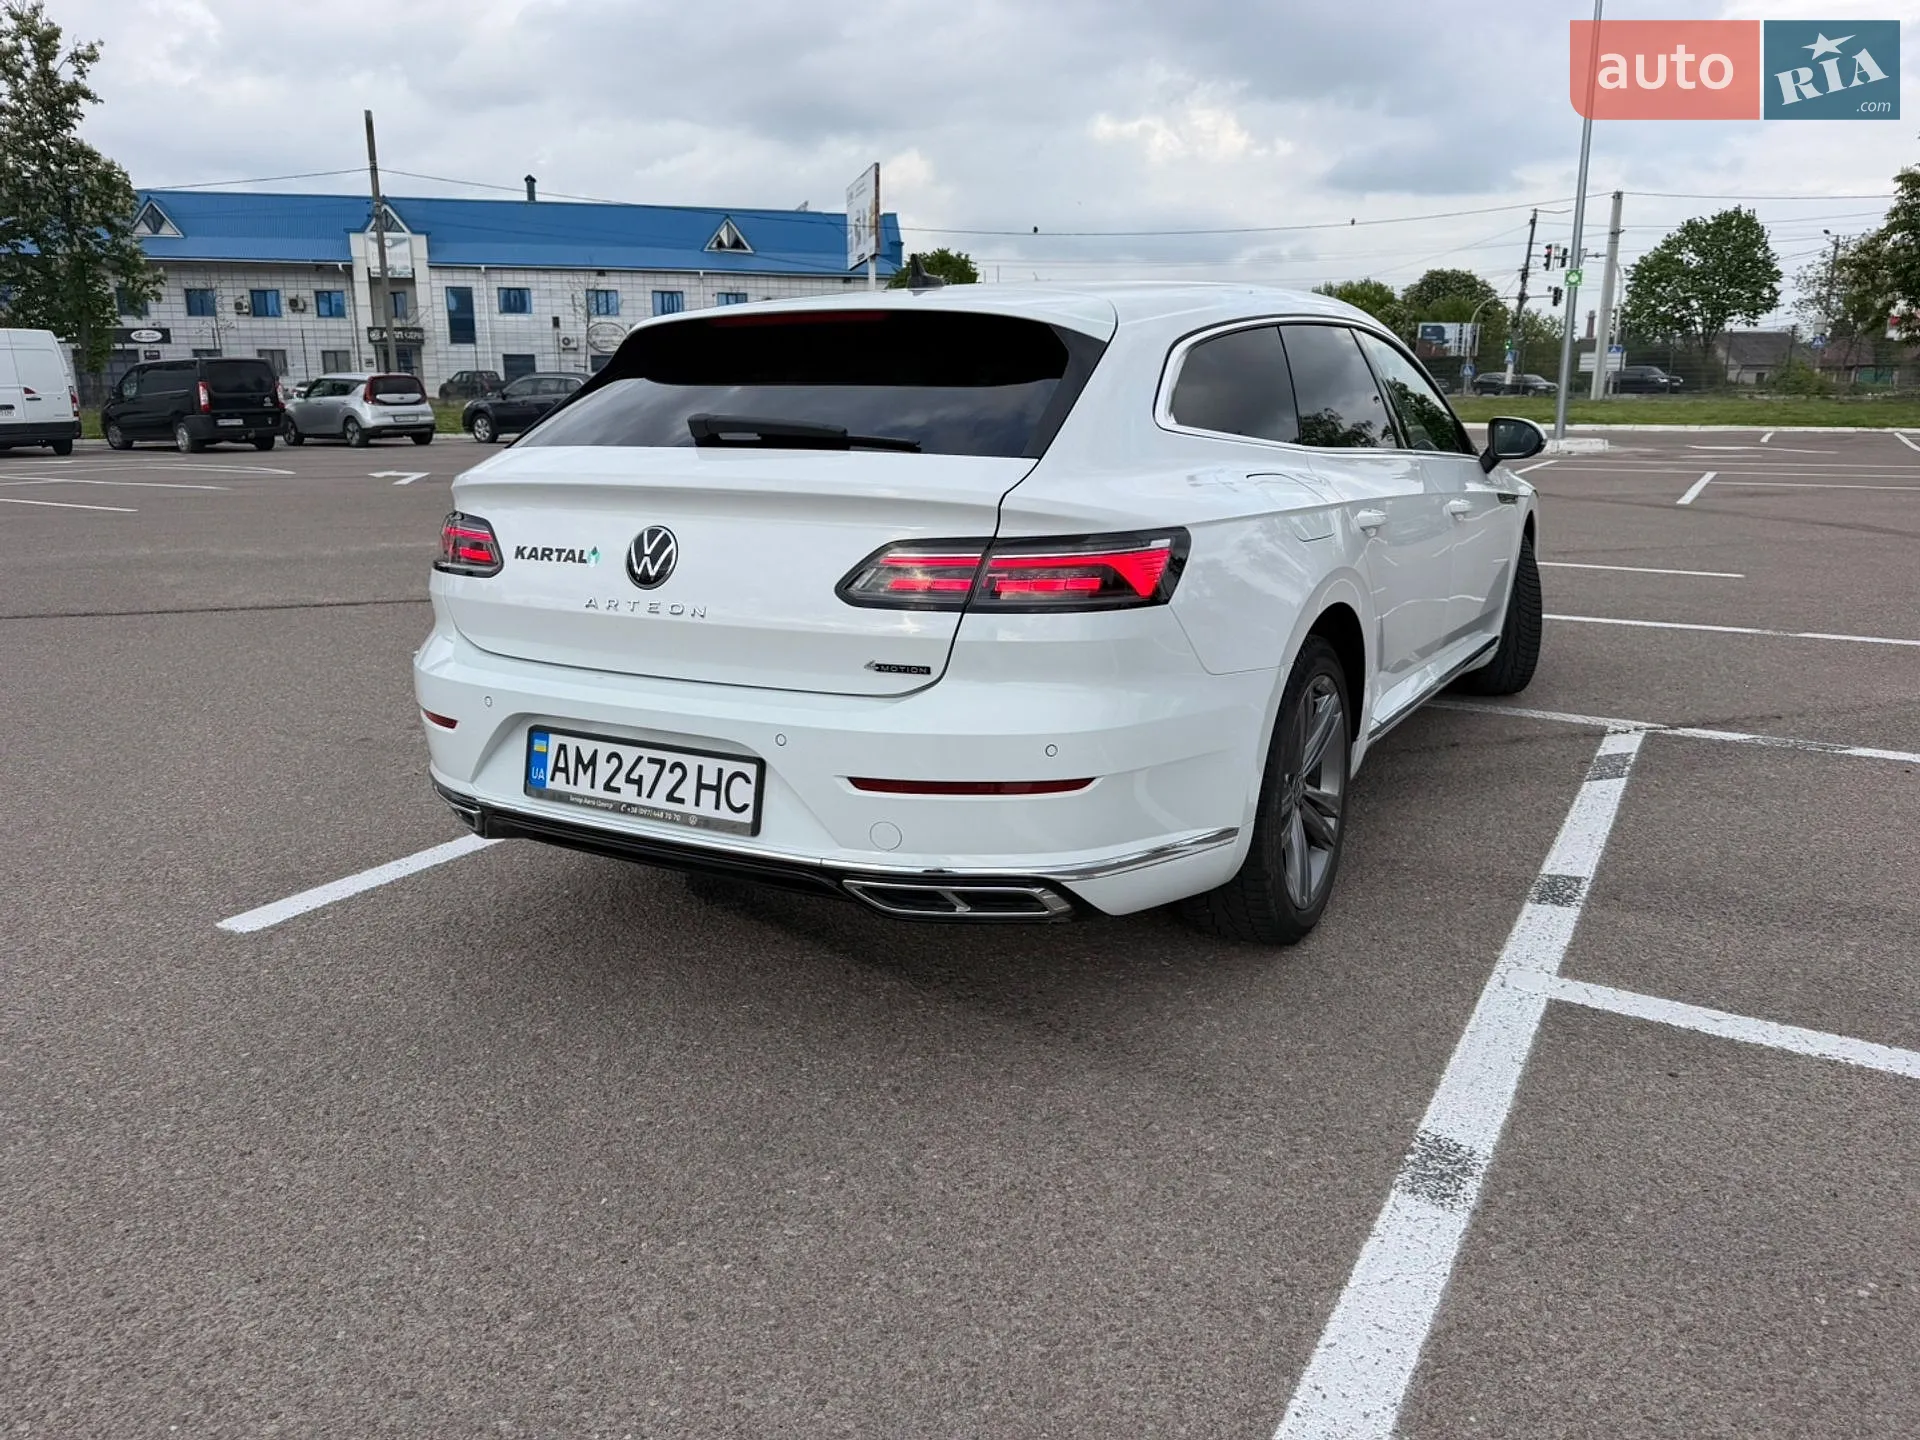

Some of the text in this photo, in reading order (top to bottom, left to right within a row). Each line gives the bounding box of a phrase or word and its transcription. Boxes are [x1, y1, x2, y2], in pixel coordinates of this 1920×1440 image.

[514, 545, 588, 564] KARTAL
[584, 596, 708, 619] ARTEON
[531, 766, 545, 781] UA
